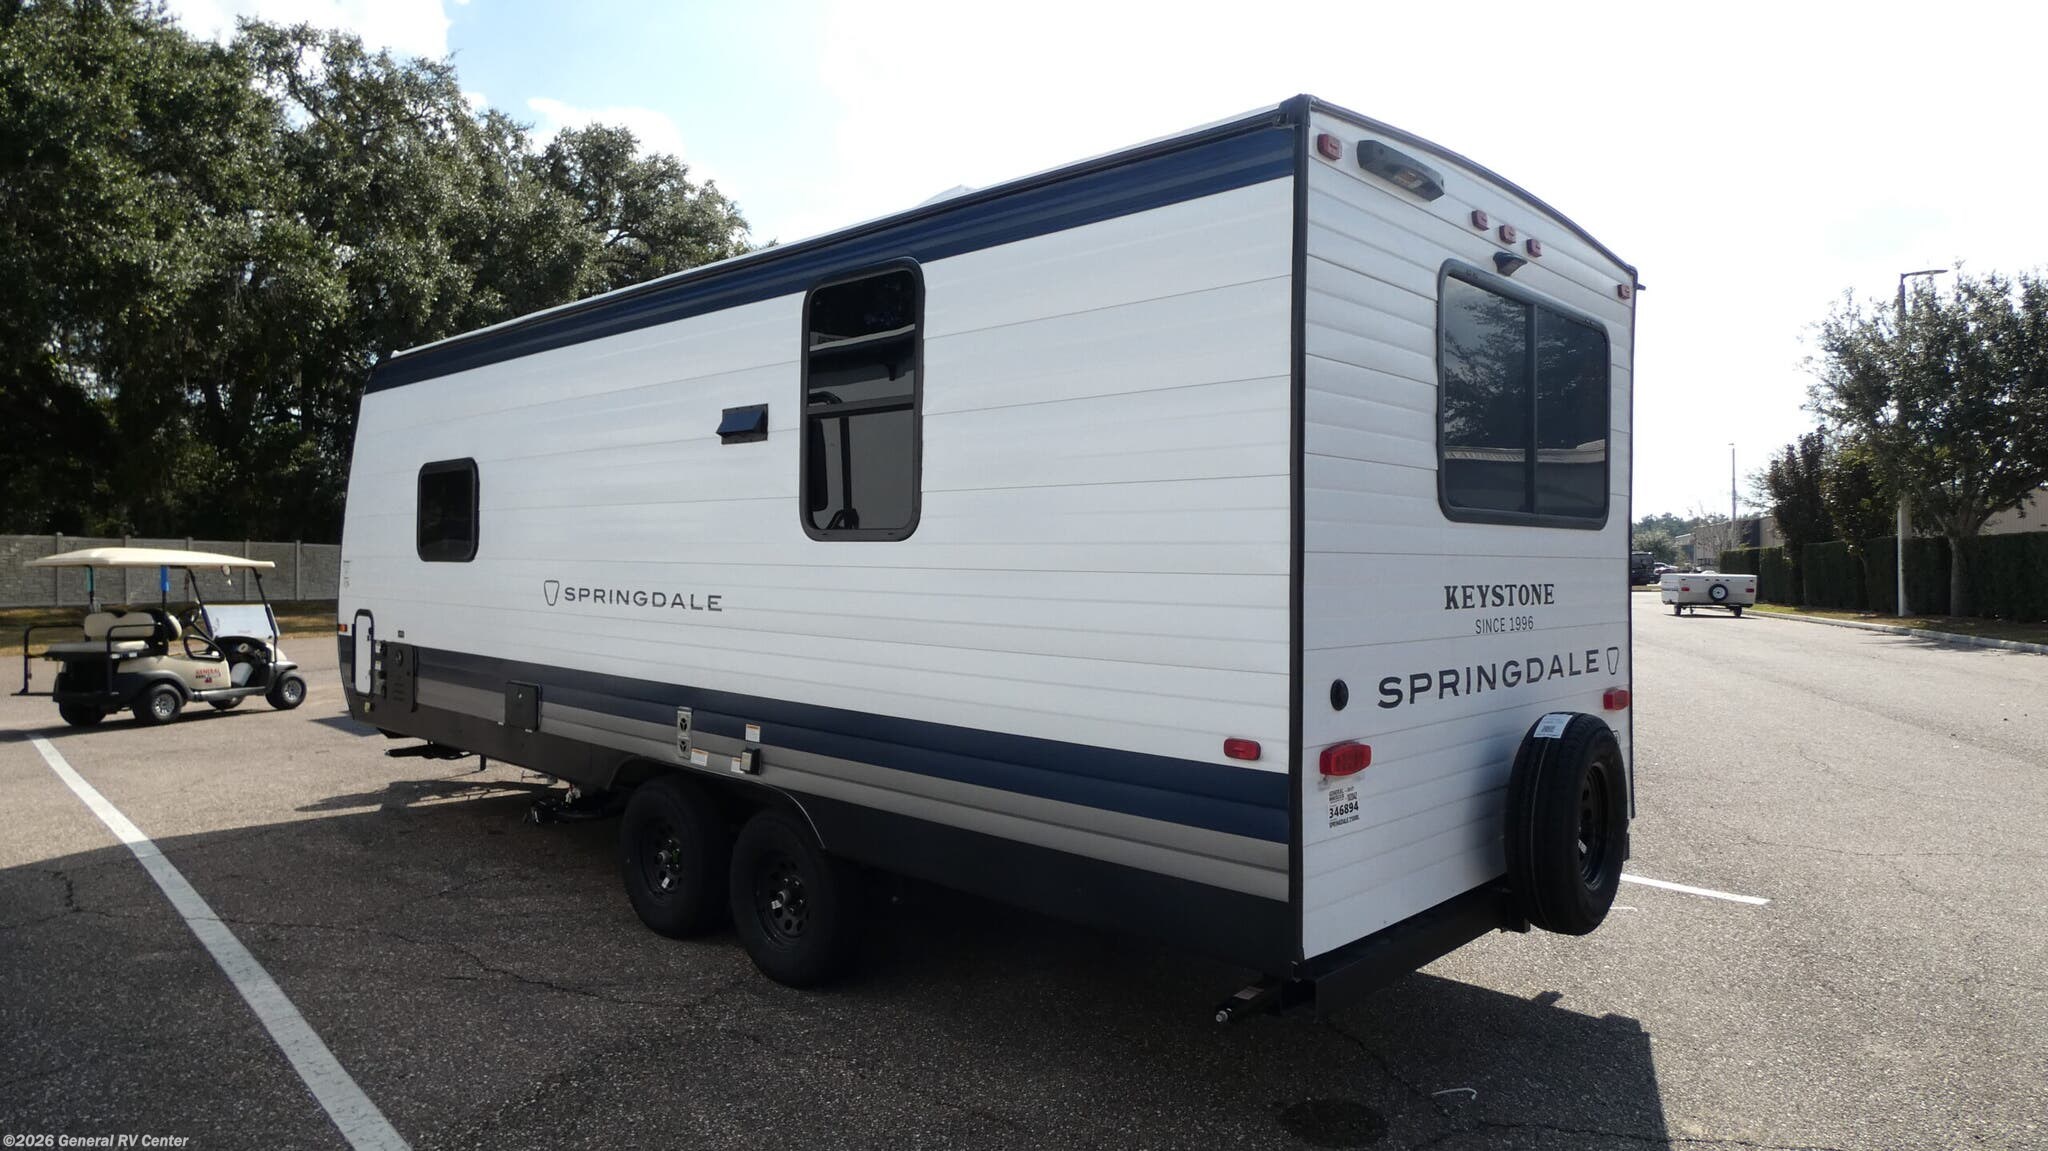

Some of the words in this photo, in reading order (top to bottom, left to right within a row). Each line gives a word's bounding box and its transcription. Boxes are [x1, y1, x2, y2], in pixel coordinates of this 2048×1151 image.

[564, 587, 723, 612] SPRINGDALE
[1444, 584, 1555, 610] KEYSTONE
[1475, 618, 1506, 634] SINCE
[1510, 615, 1534, 631] 1996
[1377, 649, 1600, 709] SPRINGDALE
[1329, 801, 1359, 818] 346894
